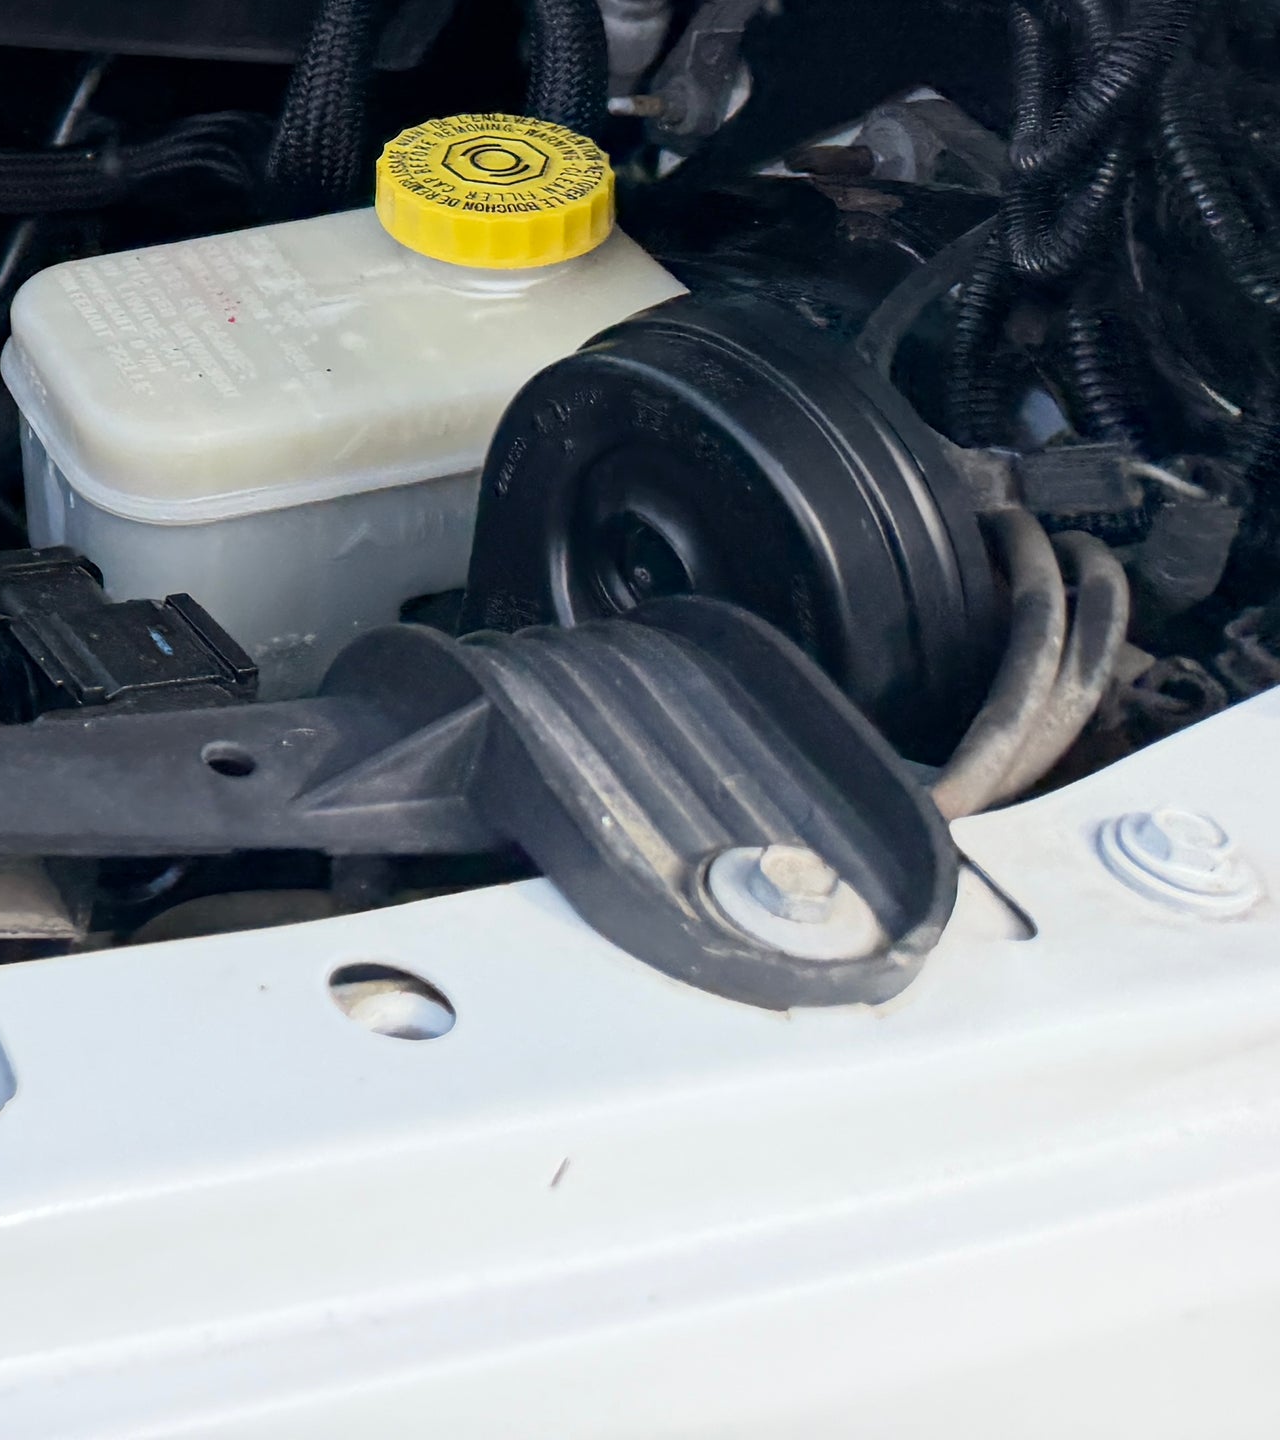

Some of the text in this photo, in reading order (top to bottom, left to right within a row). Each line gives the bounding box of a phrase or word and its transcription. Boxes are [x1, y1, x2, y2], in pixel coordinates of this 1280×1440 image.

[433, 123, 514, 139] REMOVING
[422, 177, 456, 194] CAP
[539, 167, 582, 195] CLEAN
[465, 191, 537, 202] FILLER
[538, 196, 567, 208] LE
[462, 201, 542, 214] BOUCHON
